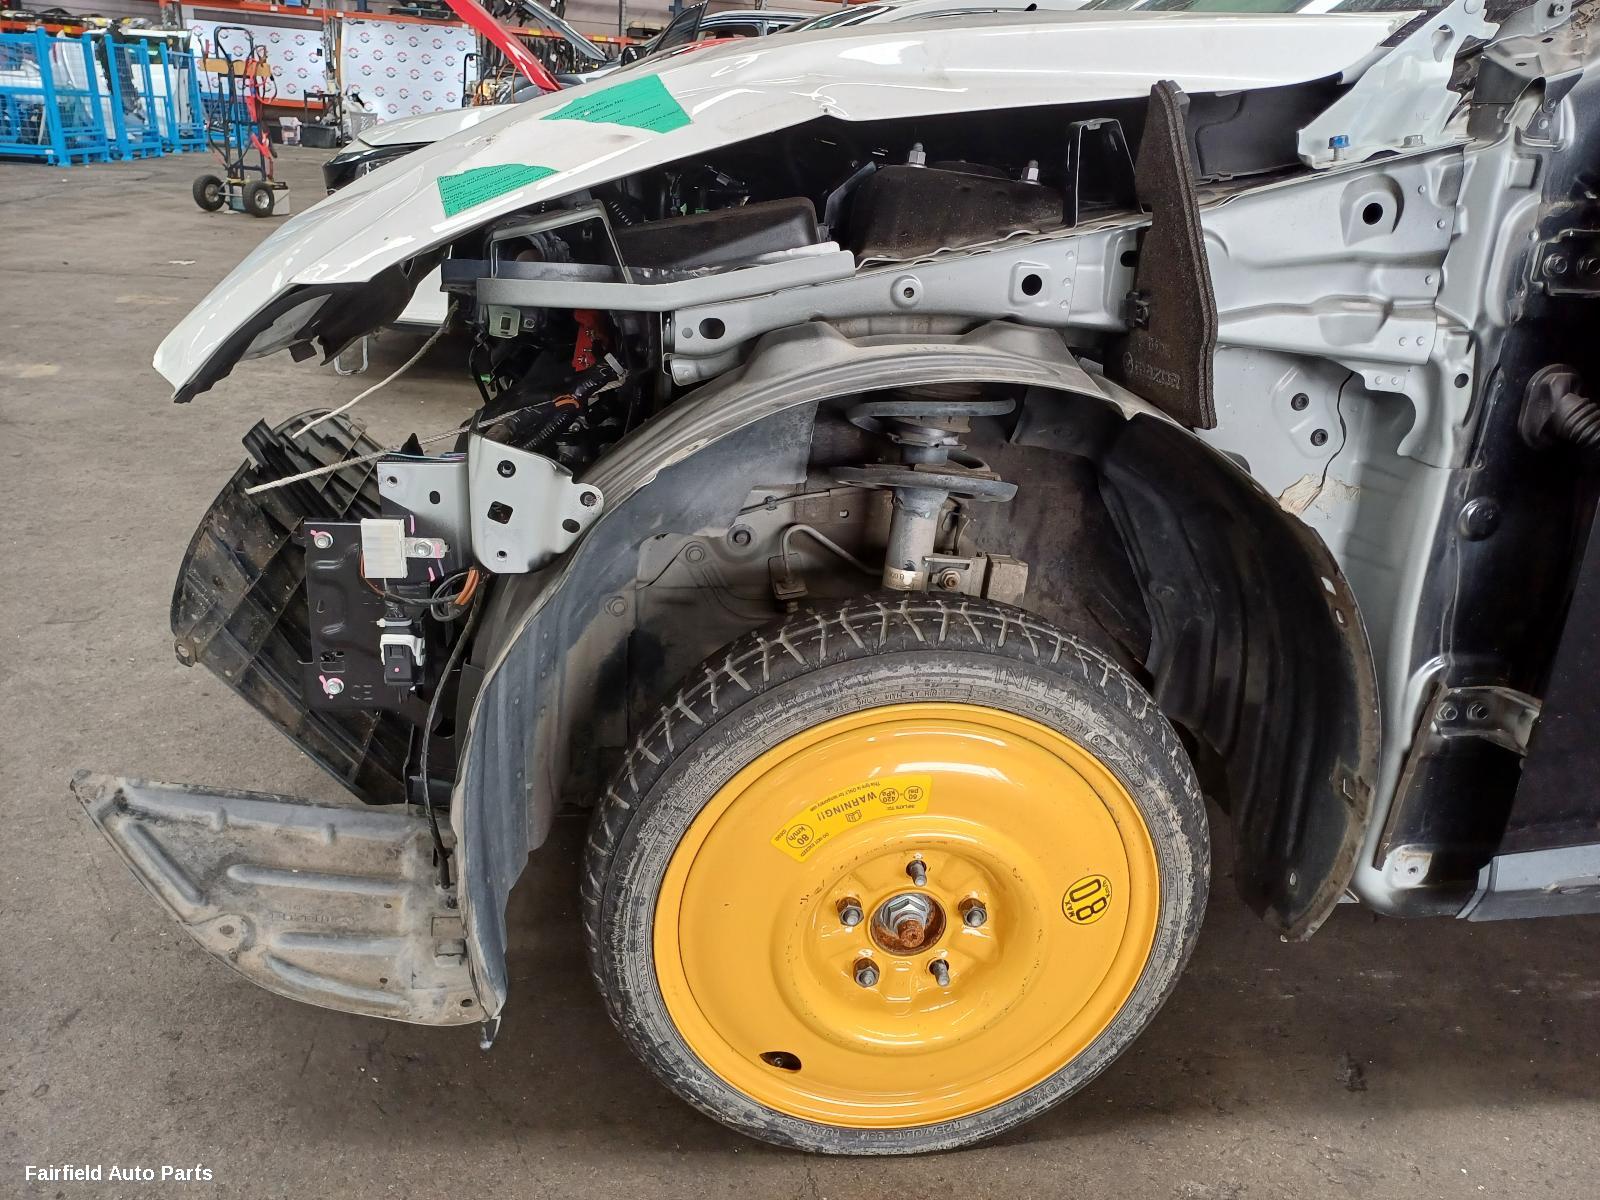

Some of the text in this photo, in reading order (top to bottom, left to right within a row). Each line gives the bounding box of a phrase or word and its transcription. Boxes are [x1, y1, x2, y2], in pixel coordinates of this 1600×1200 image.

[882, 789, 896, 797] kPa
[882, 795, 896, 803] 420
[816, 791, 878, 821] WARNING!!
[787, 826, 806, 841] km/h
[796, 833, 810, 845] 80
[1069, 878, 1108, 921] 80
[1064, 900, 1075, 917] MAX
